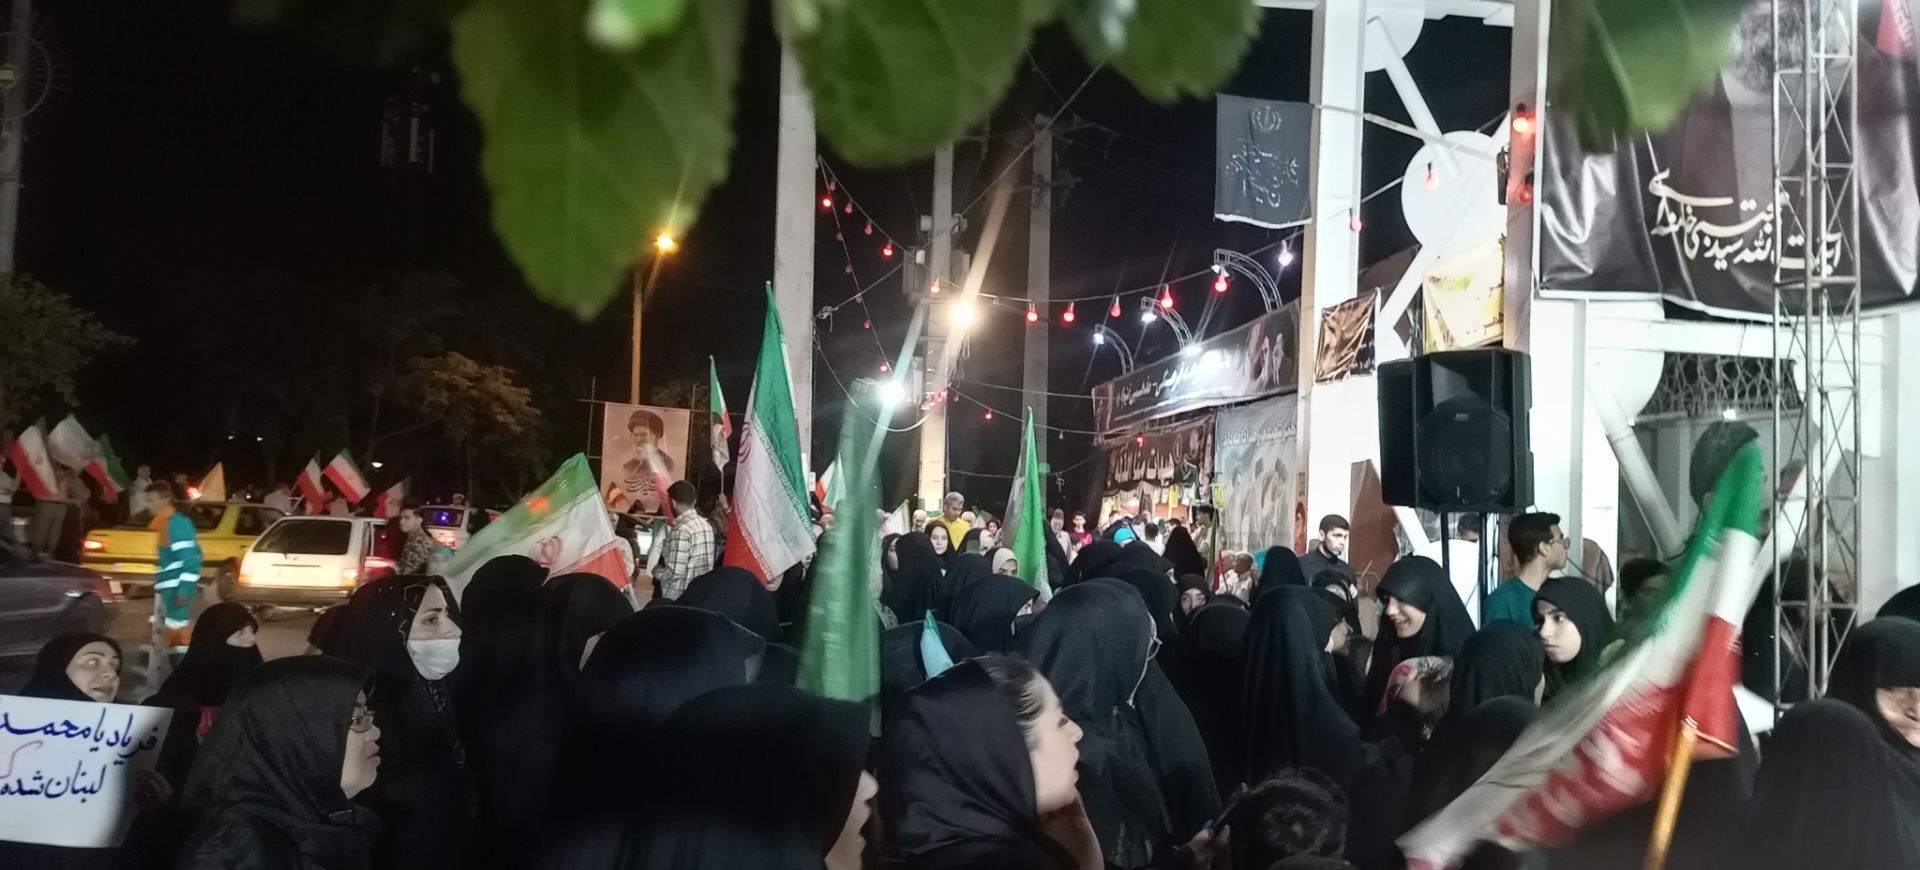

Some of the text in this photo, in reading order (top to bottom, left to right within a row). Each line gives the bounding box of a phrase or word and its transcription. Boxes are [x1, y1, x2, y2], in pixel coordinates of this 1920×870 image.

[1704, 237, 1744, 271] سید
[106, 713, 158, 766] فریاد
[0, 760, 108, 804] لبنان شده
